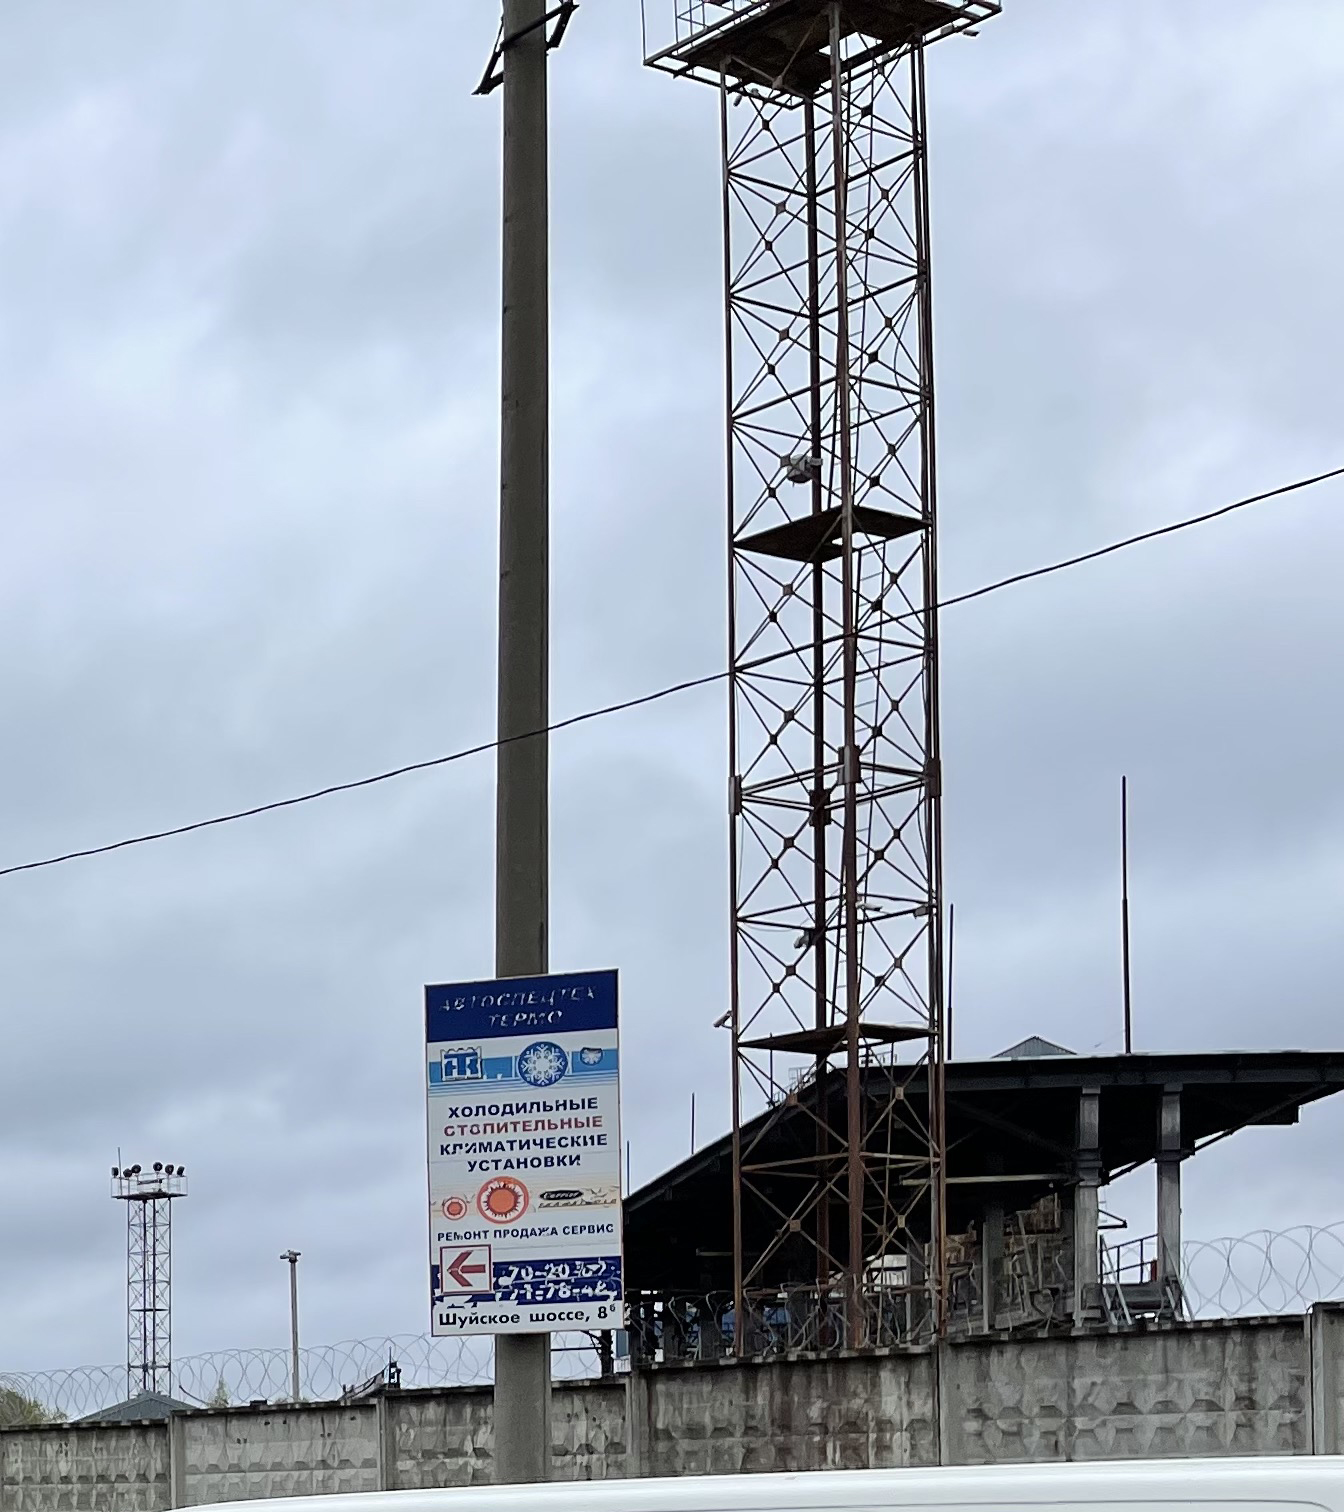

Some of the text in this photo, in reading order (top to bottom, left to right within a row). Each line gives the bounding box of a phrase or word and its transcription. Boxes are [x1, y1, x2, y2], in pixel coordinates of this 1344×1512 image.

[448, 1097, 599, 1119] ХОЛОДИЛЬНЫЕ
[439, 1133, 608, 1156] КЛИМАТИЧЕСКИЕ
[467, 1154, 581, 1172] УСТАНОВКИ
[437, 1223, 615, 1242] РЕМОНТ ПРОДАЖА СЕРВИС
[439, 1311, 521, 1328] Шуйское
[529, 1310, 591, 1323] шоссе,
